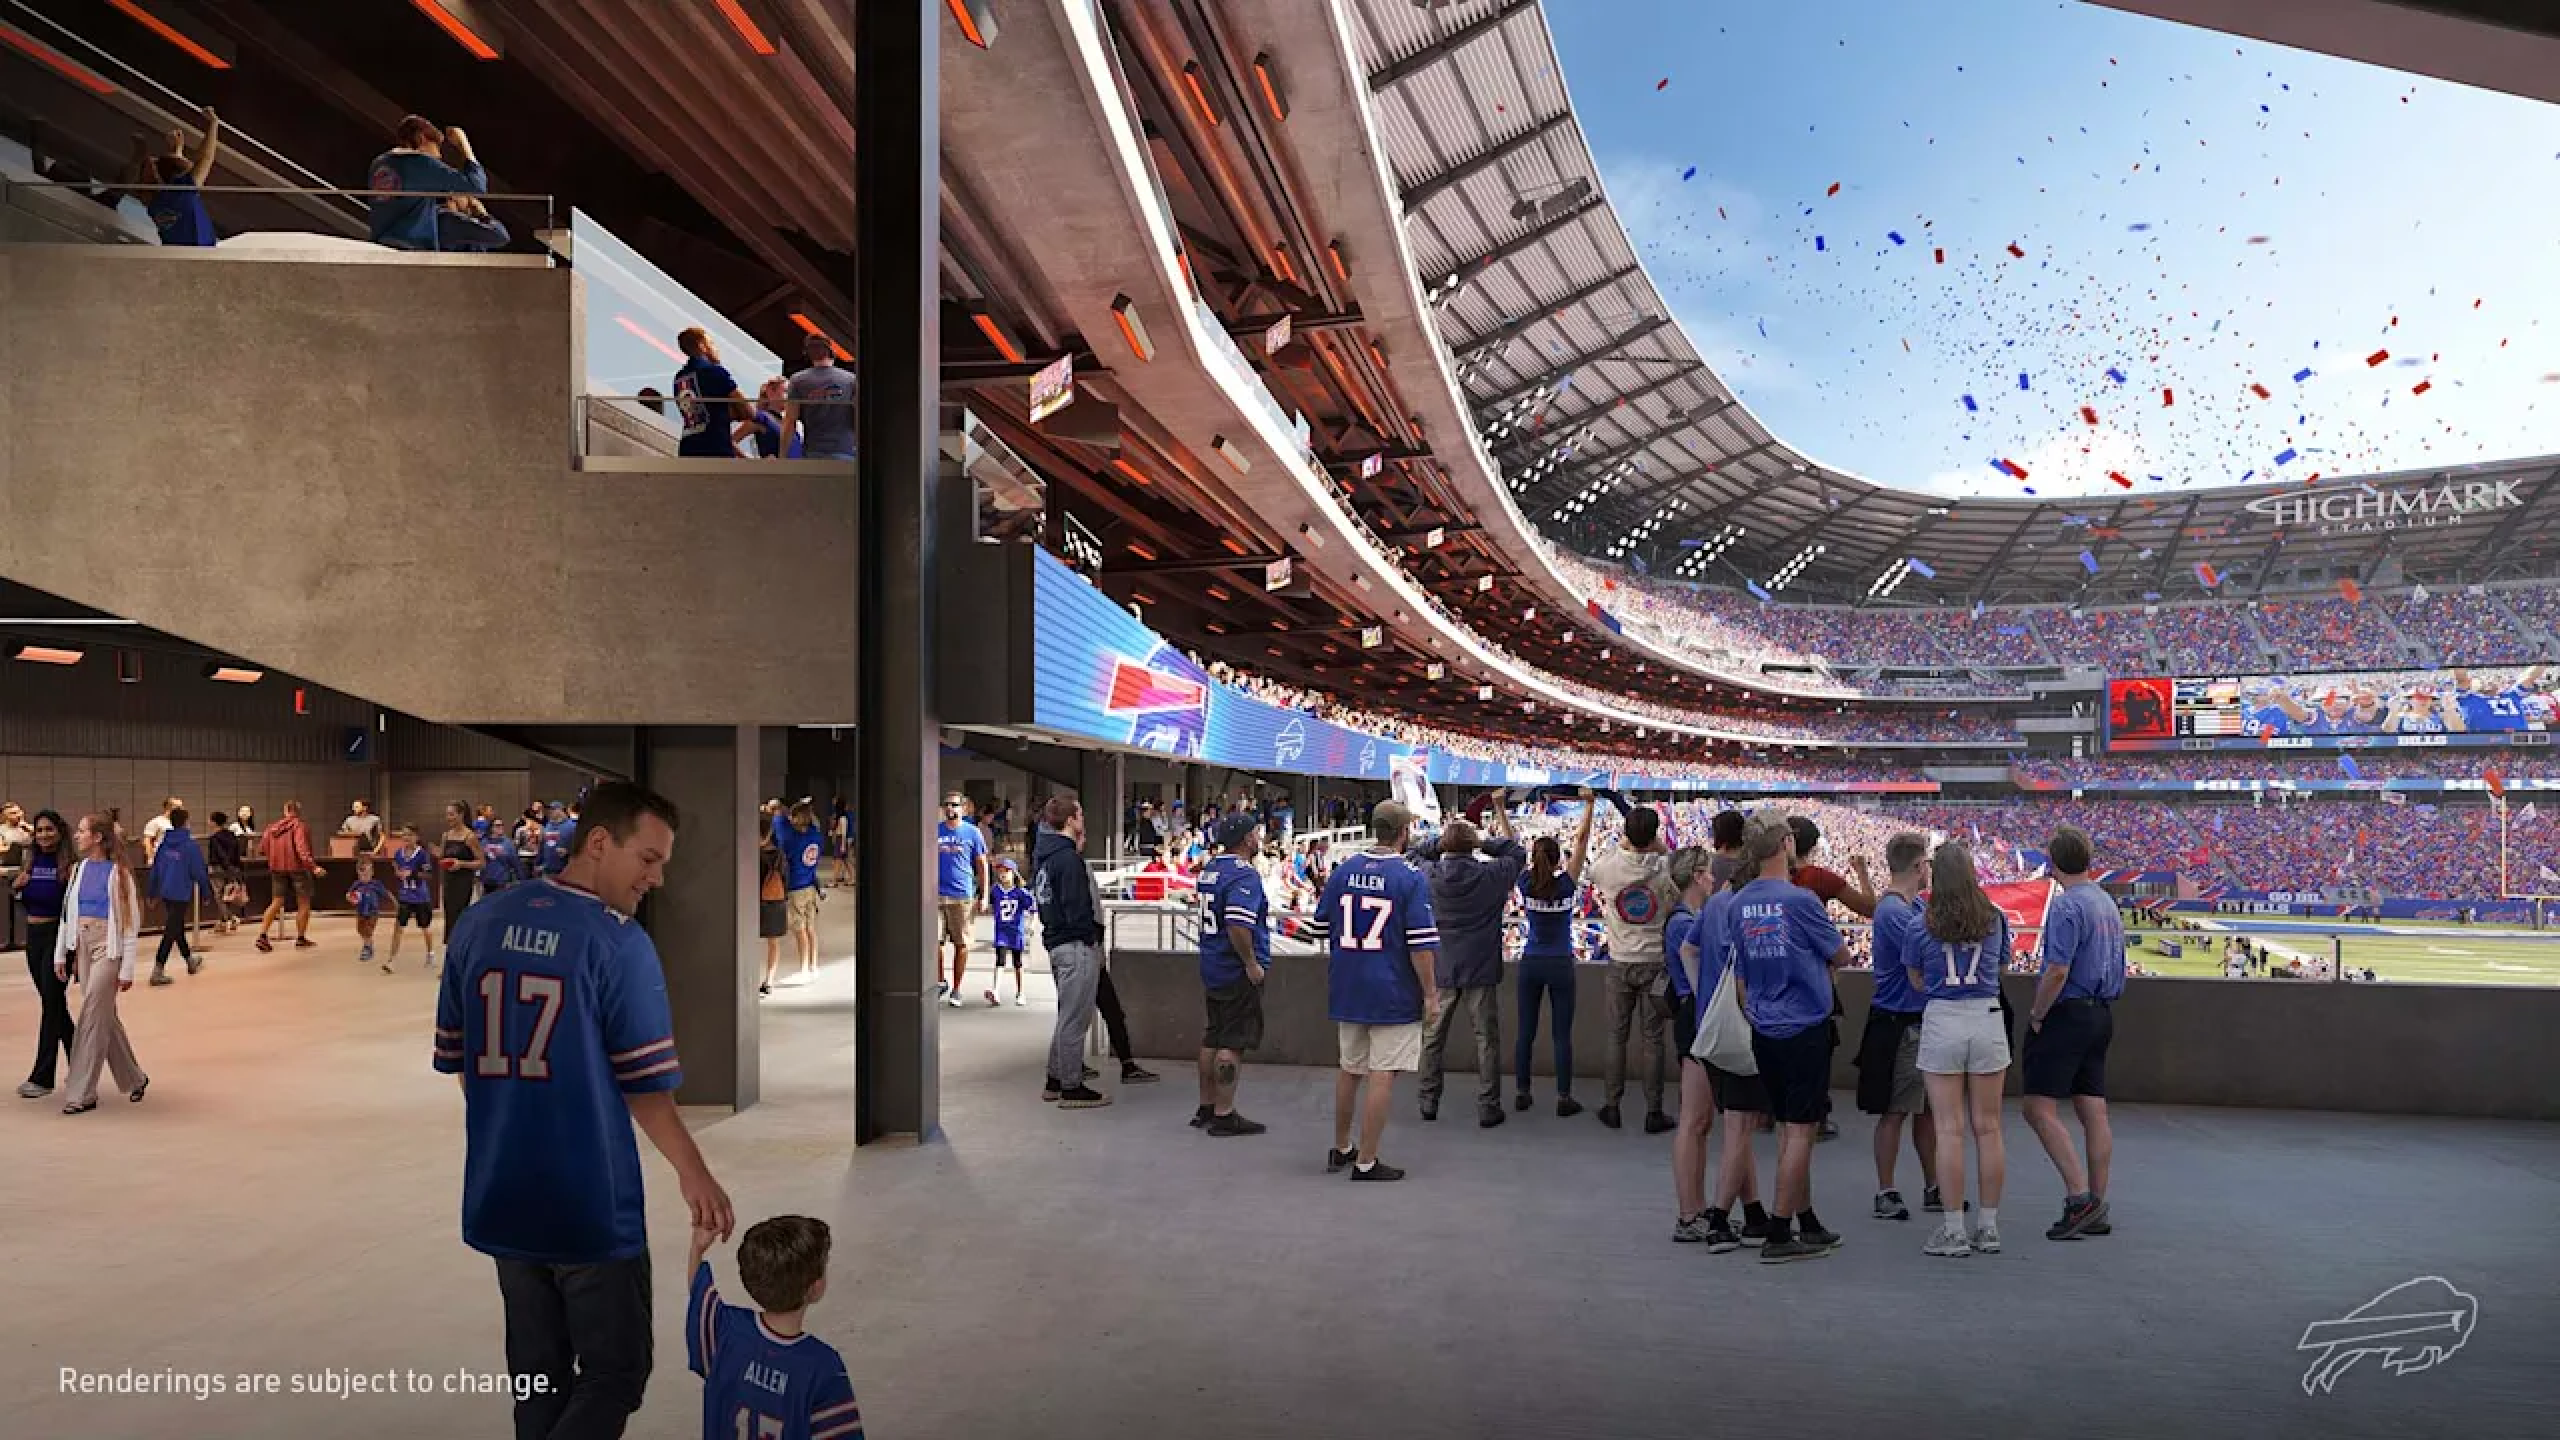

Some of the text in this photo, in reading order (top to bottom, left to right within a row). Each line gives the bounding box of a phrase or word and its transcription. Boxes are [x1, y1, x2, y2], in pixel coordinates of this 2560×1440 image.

[2274, 477, 2523, 525] HIGHMARK
[2320, 514, 2462, 535] STADIUM
[1347, 873, 1385, 891] ALLEN
[1339, 893, 1393, 950] 17
[1742, 903, 1783, 919] BILLS
[501, 923, 561, 957] ALLEN
[1942, 941, 1983, 987] 17
[477, 970, 565, 1078] 17
[743, 1360, 789, 1396] ALLEN
